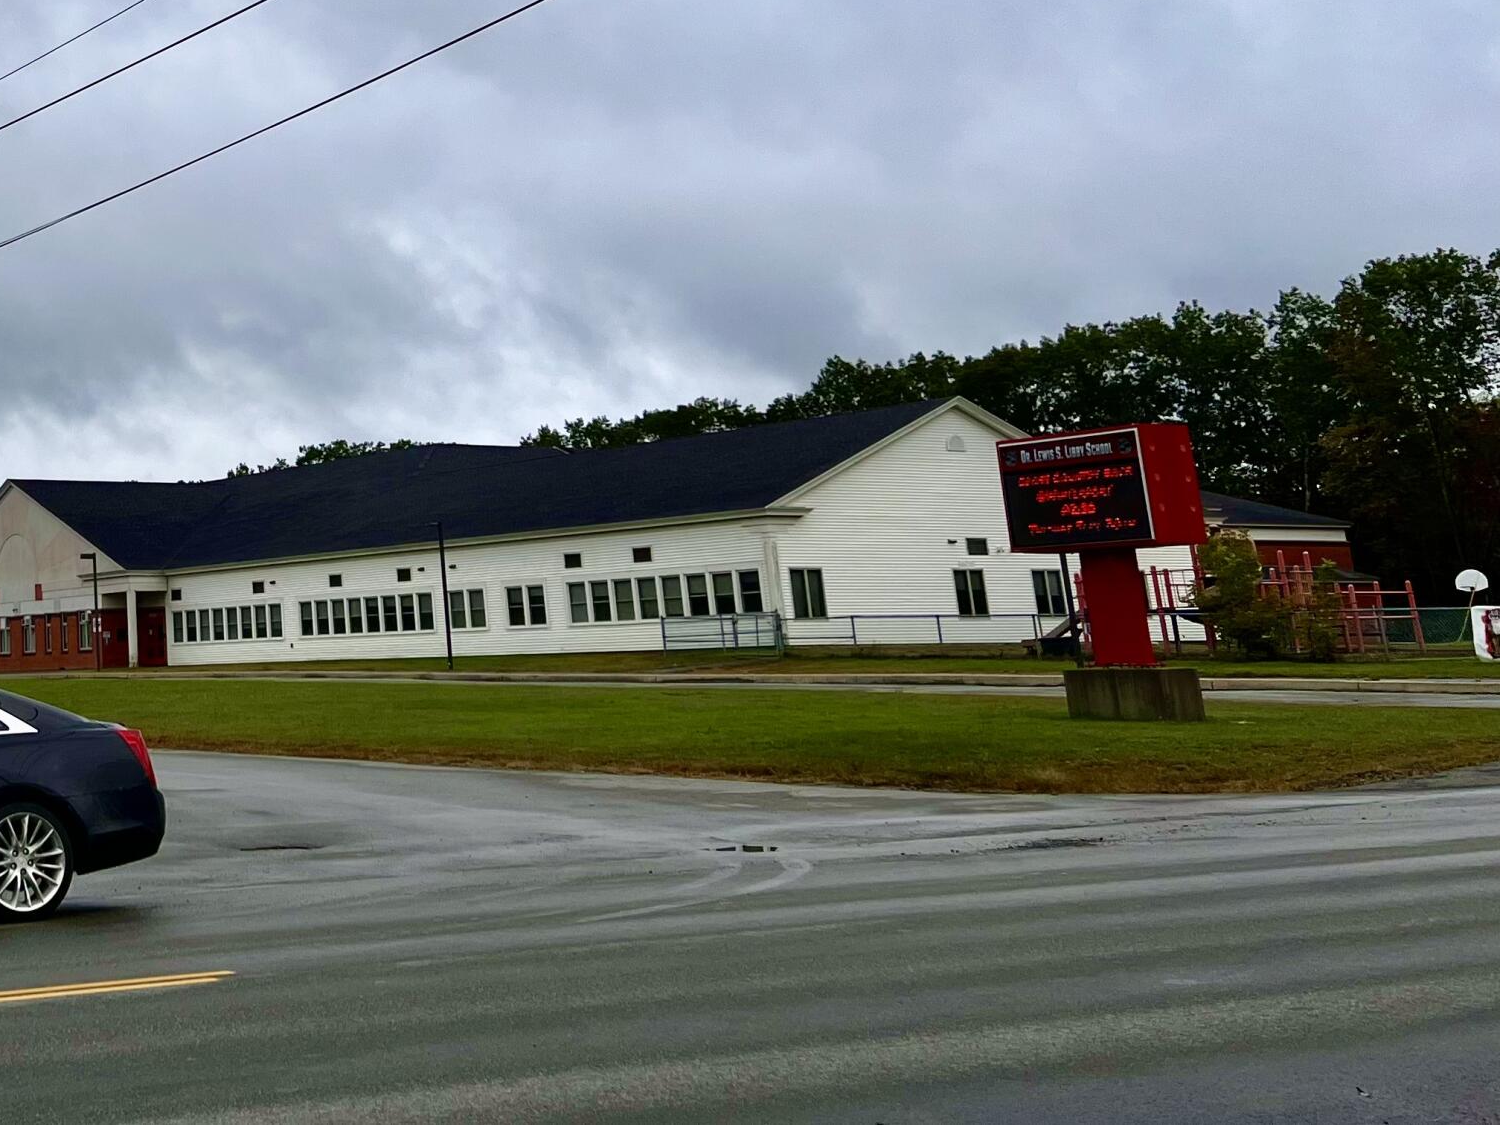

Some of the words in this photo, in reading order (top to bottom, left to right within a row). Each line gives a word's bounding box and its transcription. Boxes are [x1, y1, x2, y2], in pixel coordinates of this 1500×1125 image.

[1033, 448, 1055, 463] LEWIS
[1055, 446, 1064, 460] S.
[1085, 442, 1113, 456] SCHOOL
